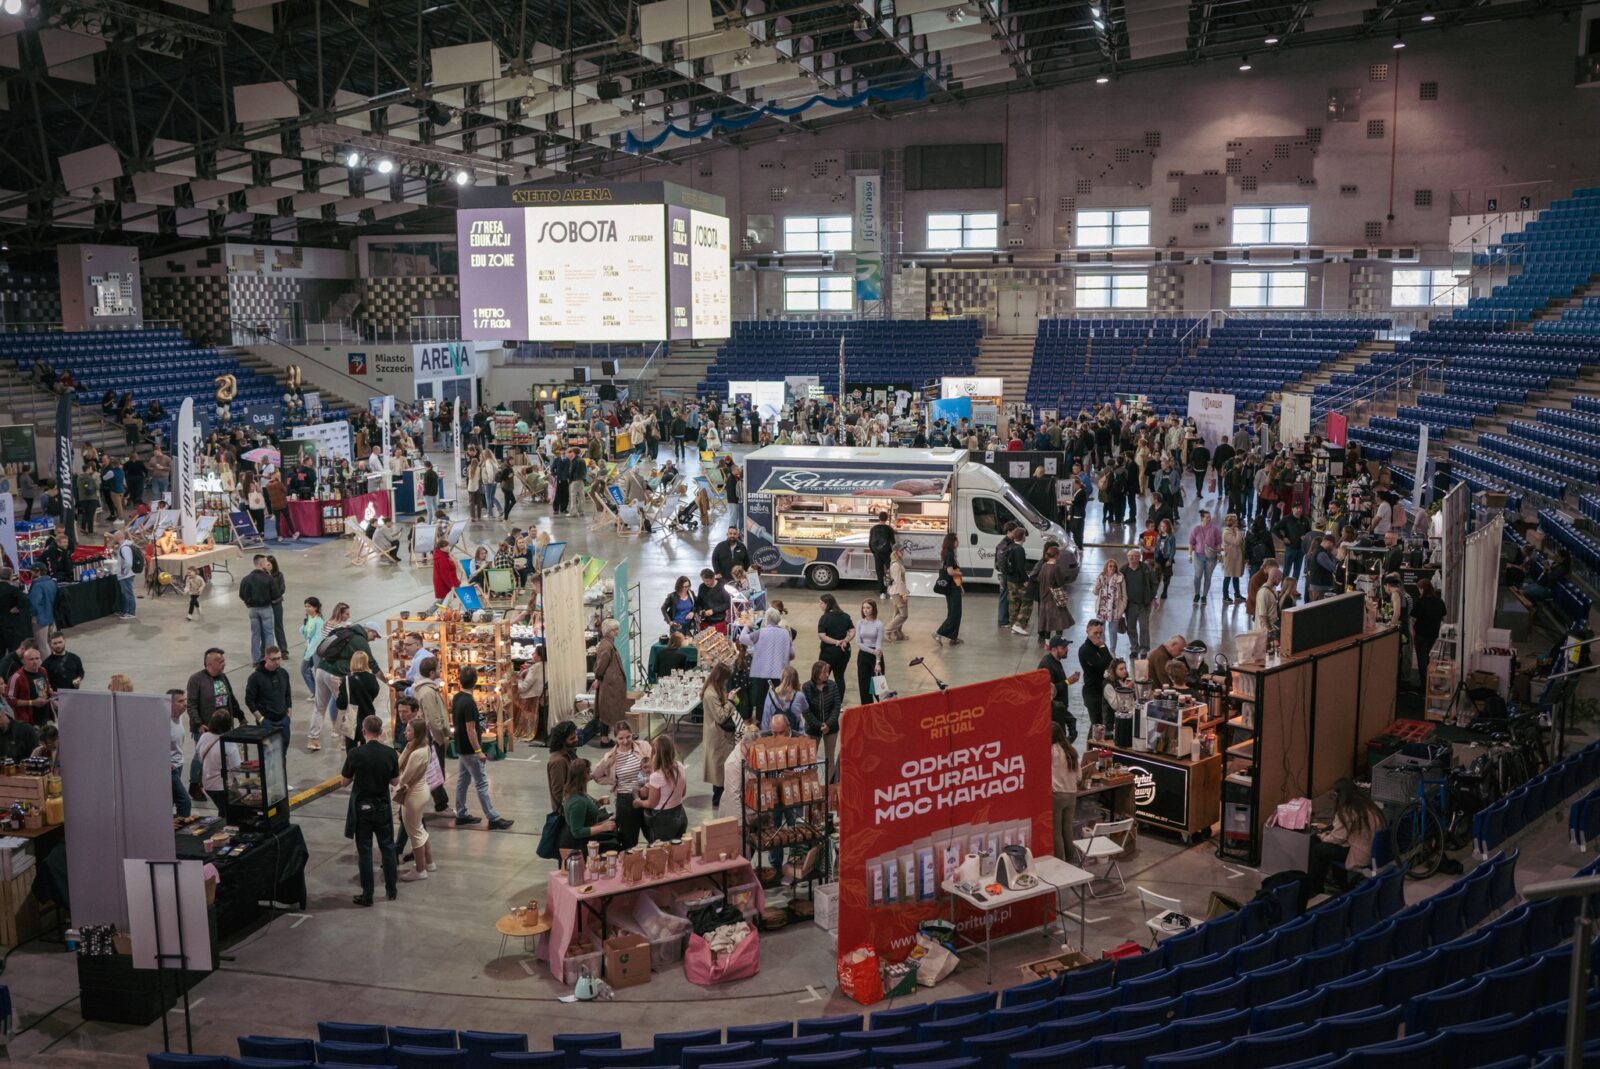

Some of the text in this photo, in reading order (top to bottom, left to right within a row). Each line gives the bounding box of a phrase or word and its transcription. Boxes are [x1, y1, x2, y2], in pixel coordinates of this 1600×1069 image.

[512, 188, 612, 202] NETTO ARENA
[470, 221, 504, 234] STREFA
[538, 220, 618, 244] SOBOTA
[470, 234, 510, 246] EDUKACJI
[694, 225, 718, 248] SOBOTA
[471, 254, 514, 267] EDU ZONE
[490, 319, 511, 328] FLOOR
[375, 354, 406, 362] Miasto
[420, 342, 470, 376] ARENA
[376, 364, 413, 373] Szczecin
[182, 441, 192, 518] Artisan
[794, 478, 885, 487] Artisan
[920, 706, 984, 730] CACAO
[930, 721, 975, 740] RITUAL
[901, 741, 1000, 778] ODKRYJ
[874, 755, 1025, 805] NATURALNĄ
[875, 774, 1024, 824] MOC KAKAO!
[1134, 787, 1151, 798] awy
